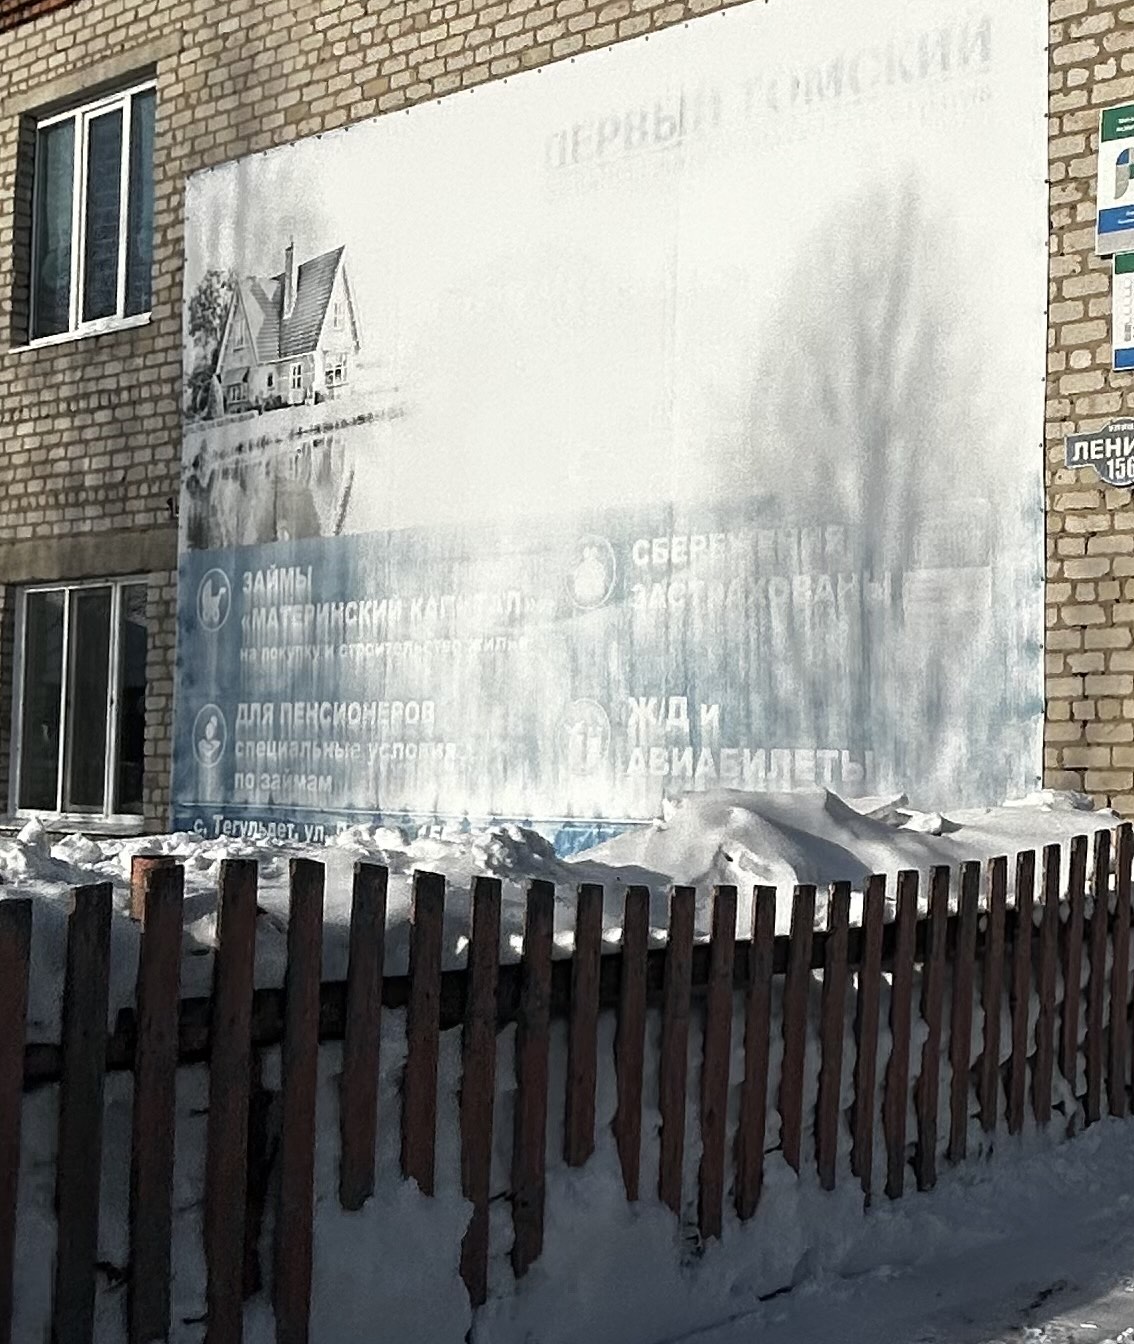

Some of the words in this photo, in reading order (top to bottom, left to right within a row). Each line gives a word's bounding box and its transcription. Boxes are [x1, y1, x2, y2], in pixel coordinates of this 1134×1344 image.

[545, 84, 722, 167] ПЕРВЫЙ
[742, 10, 991, 117] ТОМСКИЙ
[242, 564, 313, 593] ЗАЙМЫ
[262, 643, 319, 662] покупку
[235, 702, 273, 726] ДЛЯ
[281, 700, 435, 726] ПЕНСИОНЕРОВ
[627, 696, 690, 732] Ж/Д
[701, 704, 720, 727] и
[235, 741, 361, 760] специальные
[627, 747, 875, 782] АВИАБИЛЕТЫ
[235, 771, 254, 789] по
[260, 769, 333, 793] займам
